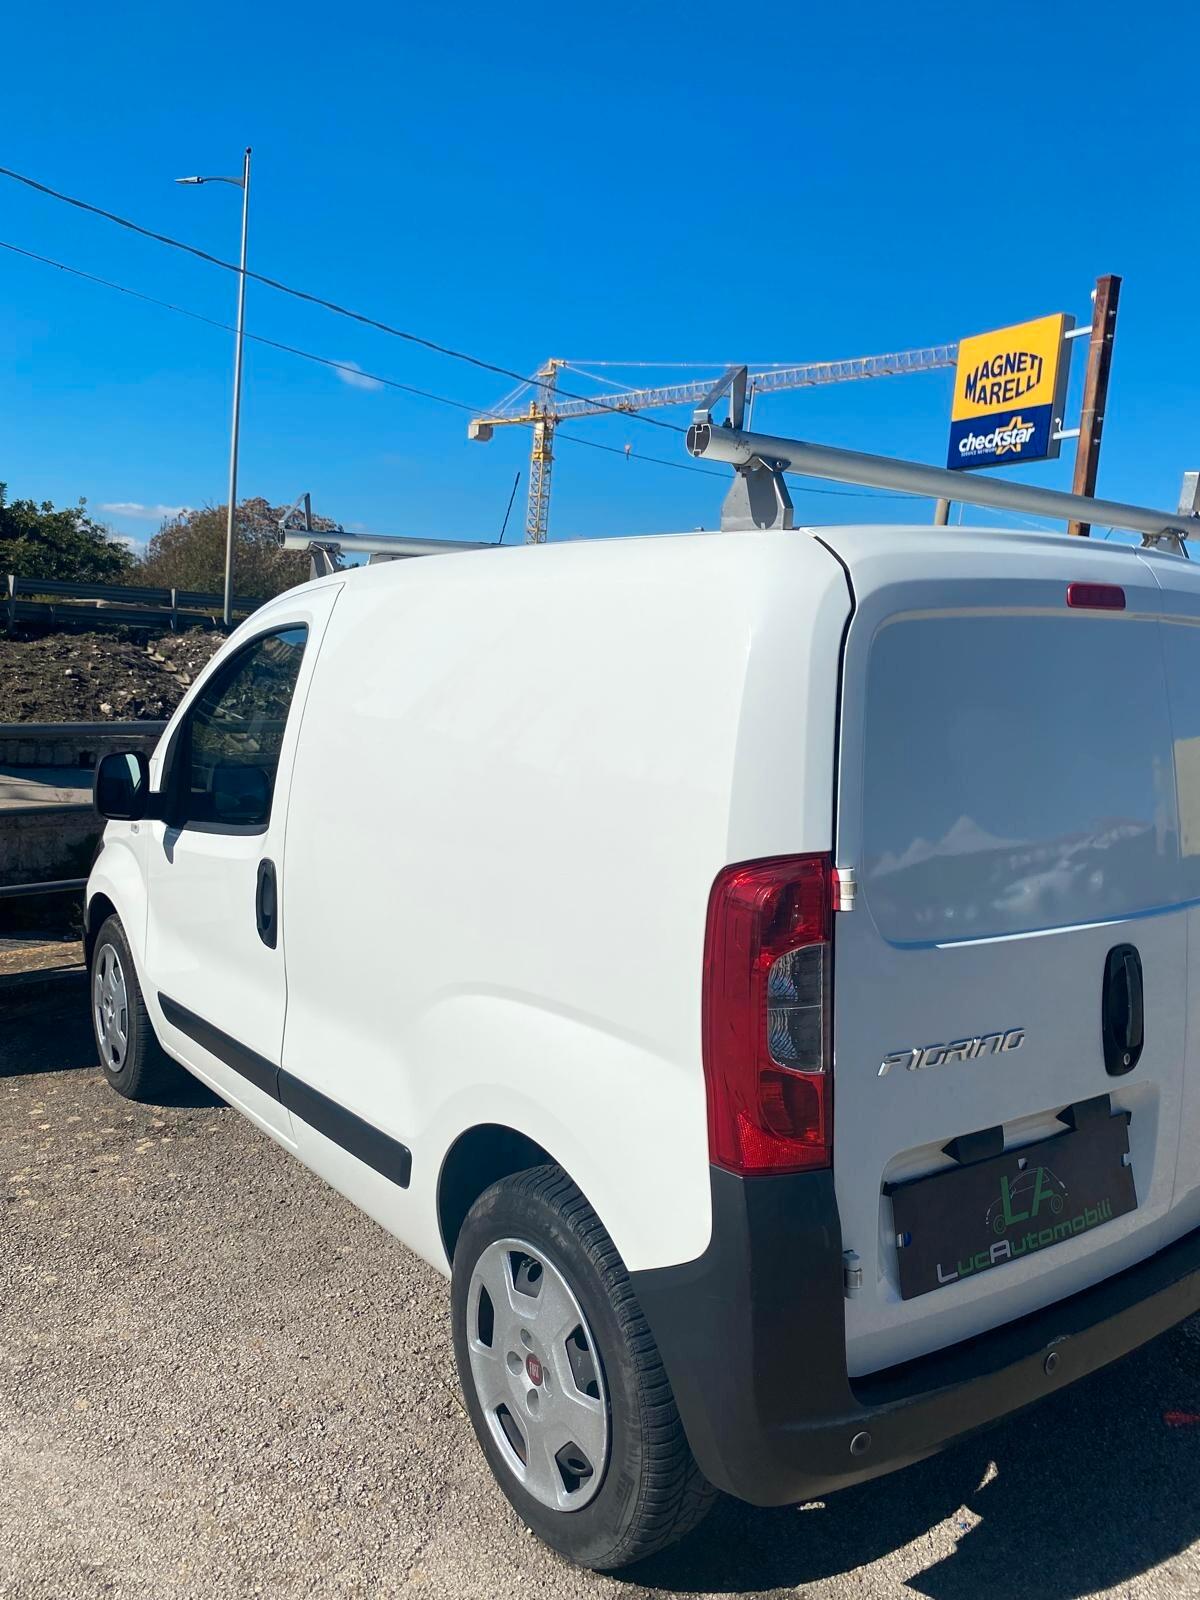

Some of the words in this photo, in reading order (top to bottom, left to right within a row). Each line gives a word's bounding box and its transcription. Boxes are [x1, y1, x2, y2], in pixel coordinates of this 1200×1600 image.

[965, 352, 1043, 387] MAGNETI
[965, 370, 1043, 405] MARELLI
[959, 427, 1035, 452] checkstar
[878, 1027, 1025, 1076] FIORINO
[936, 1198, 1113, 1284] LucAutomobili
